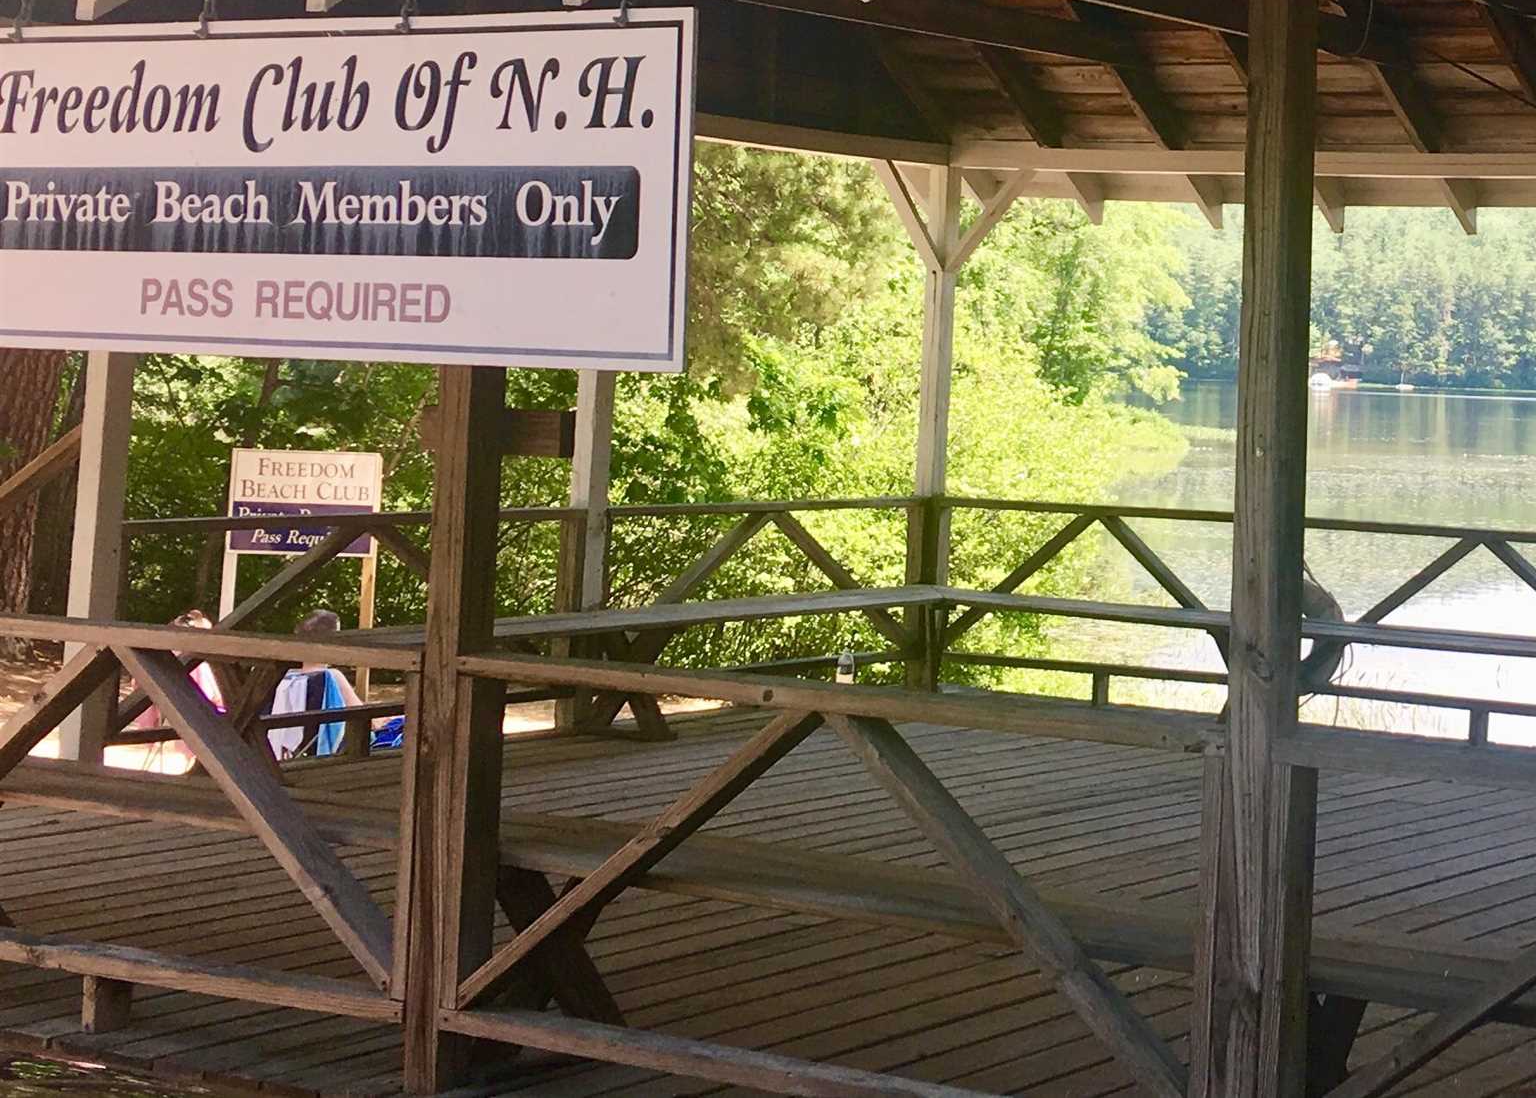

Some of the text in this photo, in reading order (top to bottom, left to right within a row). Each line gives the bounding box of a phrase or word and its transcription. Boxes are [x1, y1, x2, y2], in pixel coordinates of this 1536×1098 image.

[0, 59, 221, 134] Freedom
[242, 54, 370, 153] Club
[394, 51, 478, 153] Of
[3, 180, 620, 245] Private Beach Members Only
[139, 278, 452, 324] PASS REQUIRED
[251, 528, 282, 544] Pass
